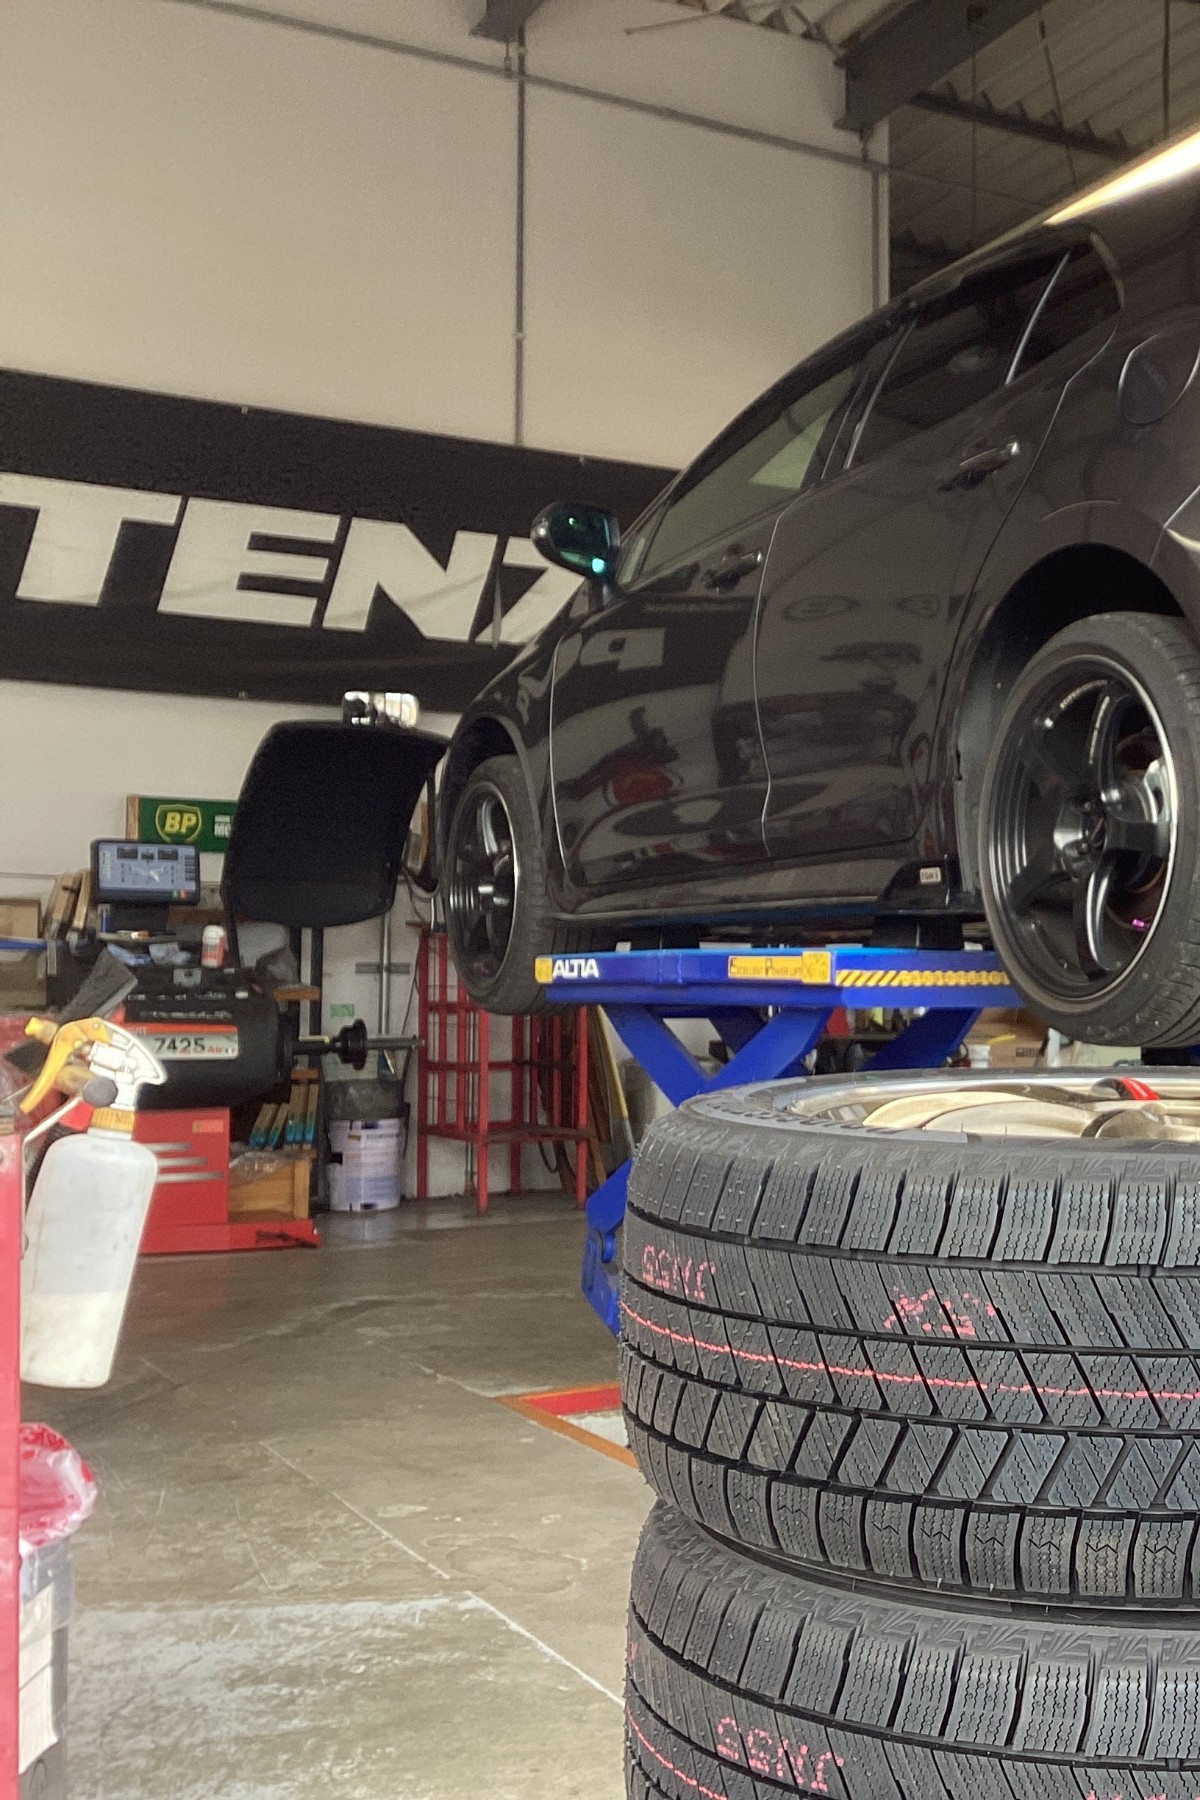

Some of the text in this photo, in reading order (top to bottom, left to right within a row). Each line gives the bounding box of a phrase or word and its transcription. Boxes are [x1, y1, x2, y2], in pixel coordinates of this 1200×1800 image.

[164, 811, 196, 834] BP
[552, 958, 600, 979] ALTIA
[154, 1037, 205, 1054] 7425
